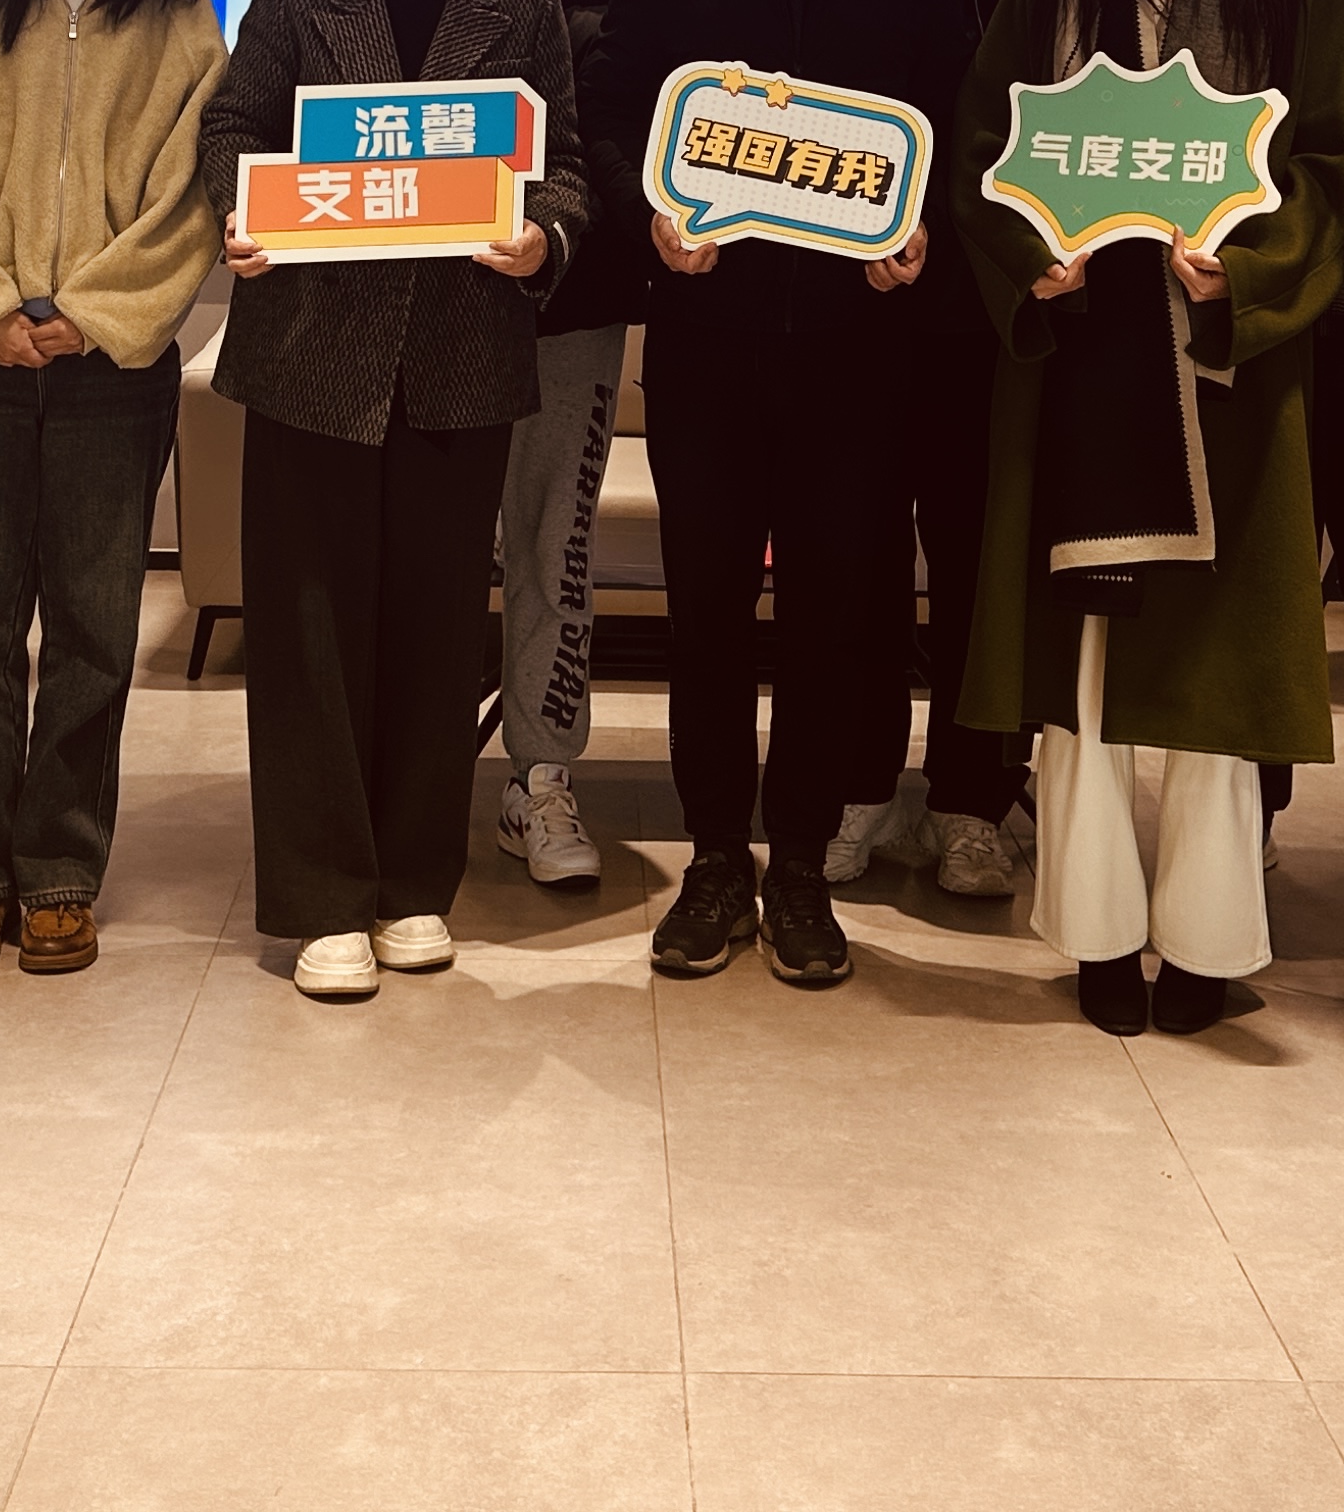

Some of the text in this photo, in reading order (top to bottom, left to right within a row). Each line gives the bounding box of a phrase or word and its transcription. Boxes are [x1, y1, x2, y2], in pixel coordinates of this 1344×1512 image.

[681, 117, 893, 203] 强国有我
[1030, 130, 1228, 185] 气度支部
[296, 166, 419, 223] 支部
